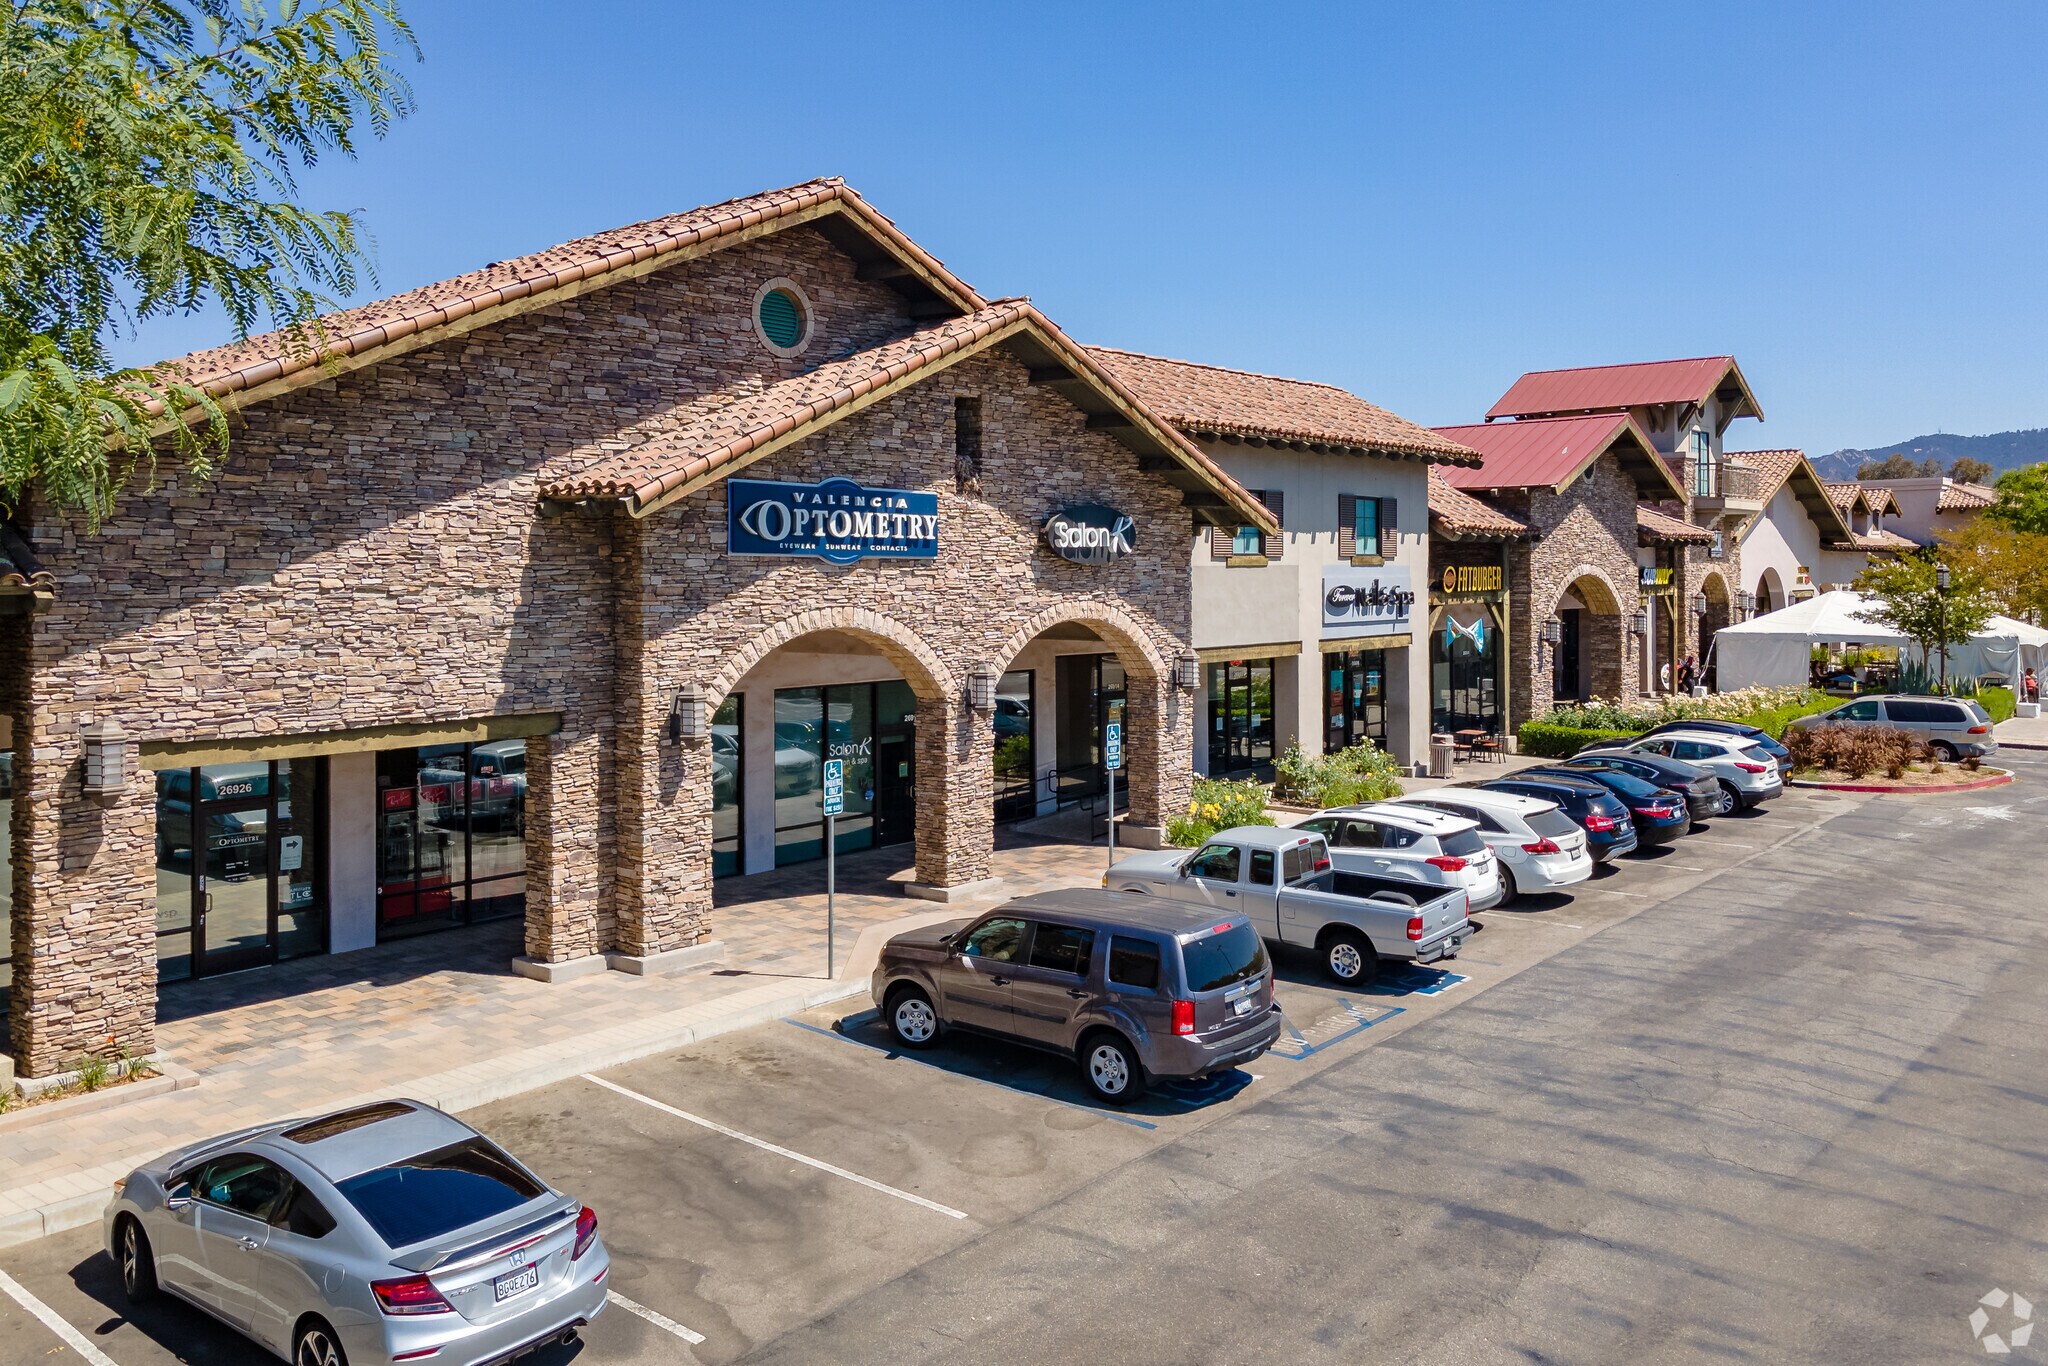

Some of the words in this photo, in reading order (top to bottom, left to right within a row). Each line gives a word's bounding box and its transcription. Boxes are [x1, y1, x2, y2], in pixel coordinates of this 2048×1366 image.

[793, 492, 908, 508] VALENCIA
[757, 500, 938, 541] OPTOMETRY
[1054, 521, 1110, 548] Salon
[1110, 516, 1134, 553] K
[825, 543, 861, 551] SUNWEAR
[1457, 566, 1502, 592] FATBURGER
[829, 742, 859, 757] Salon
[859, 736, 872, 756] K
[220, 783, 253, 796] 26926
[218, 834, 260, 847] OPTOMETRY
[498, 1270, 536, 1296] 8GQE276
